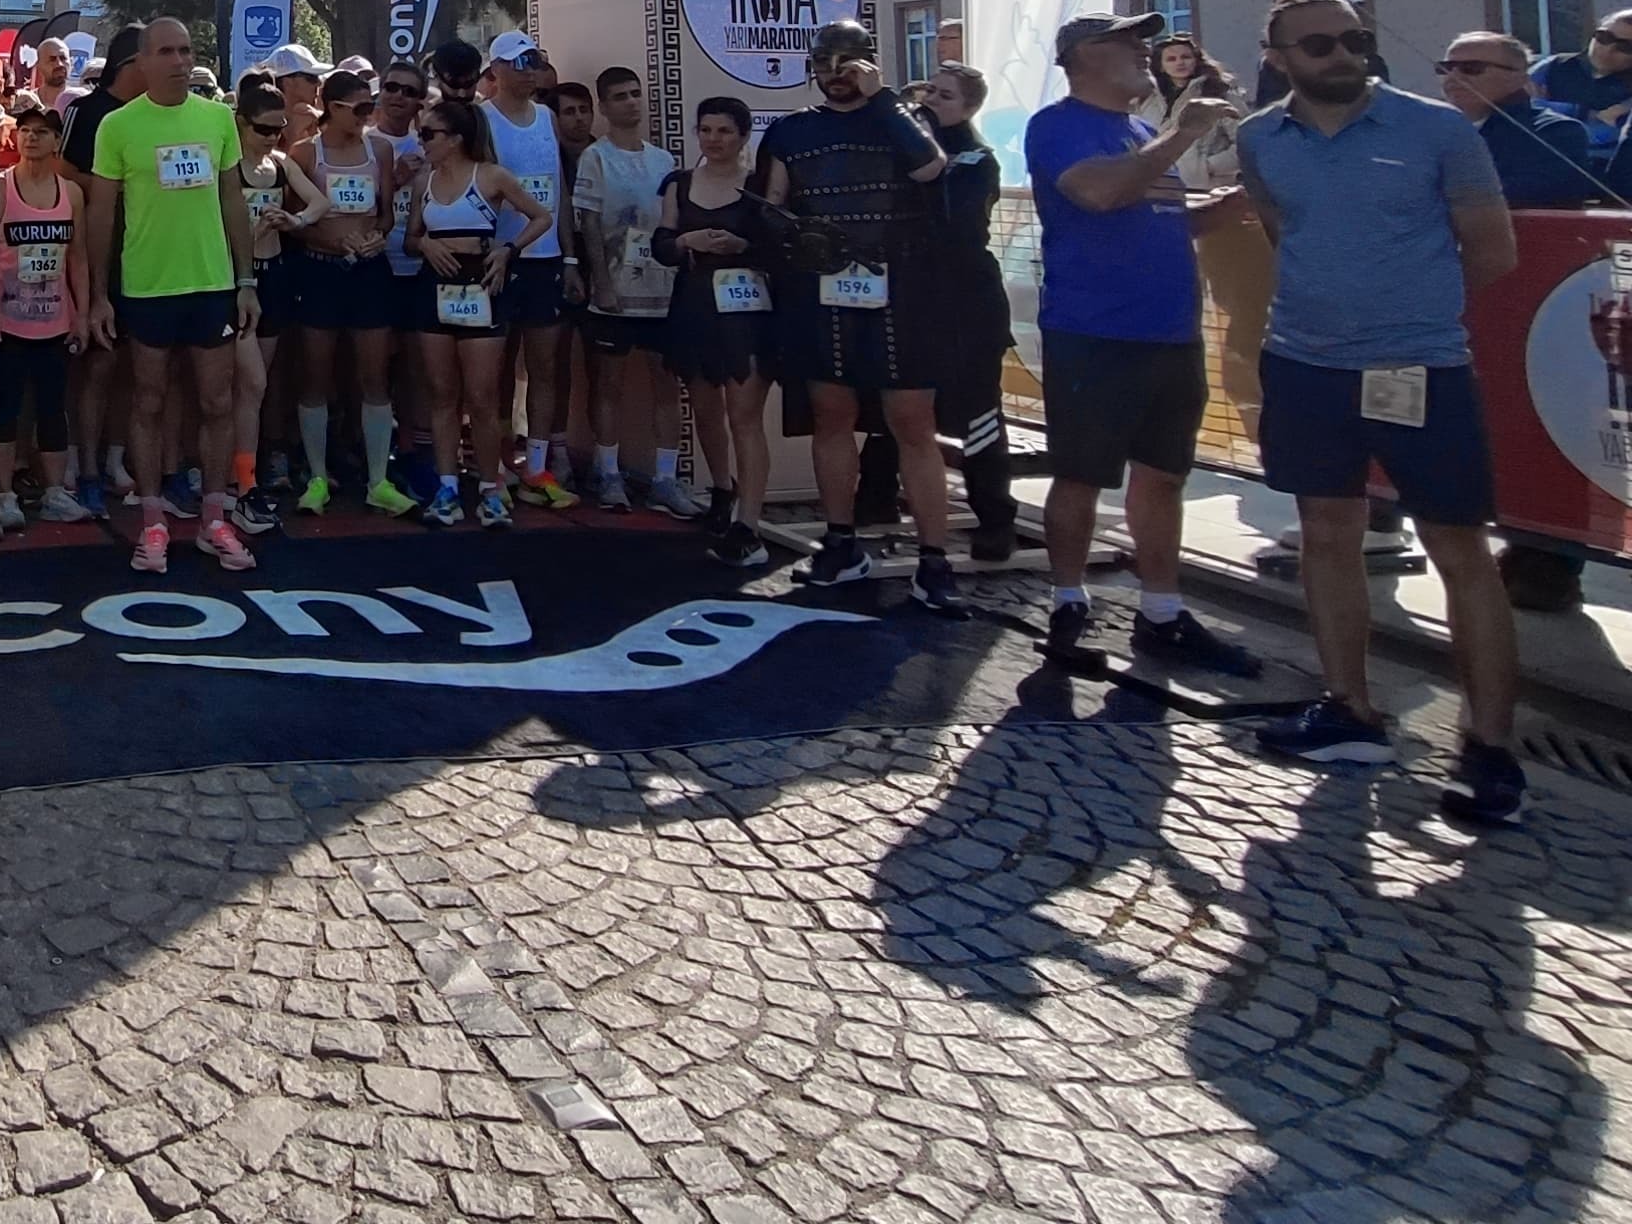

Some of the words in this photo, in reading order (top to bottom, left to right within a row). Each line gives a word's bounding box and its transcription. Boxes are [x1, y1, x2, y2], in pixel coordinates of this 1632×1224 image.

[175, 163, 200, 176] 1131
[338, 191, 365, 202] 1536
[30, 260, 57, 271] 1362
[728, 287, 759, 299] 1566
[837, 280, 871, 294] 1596
[450, 303, 479, 315] 1468
